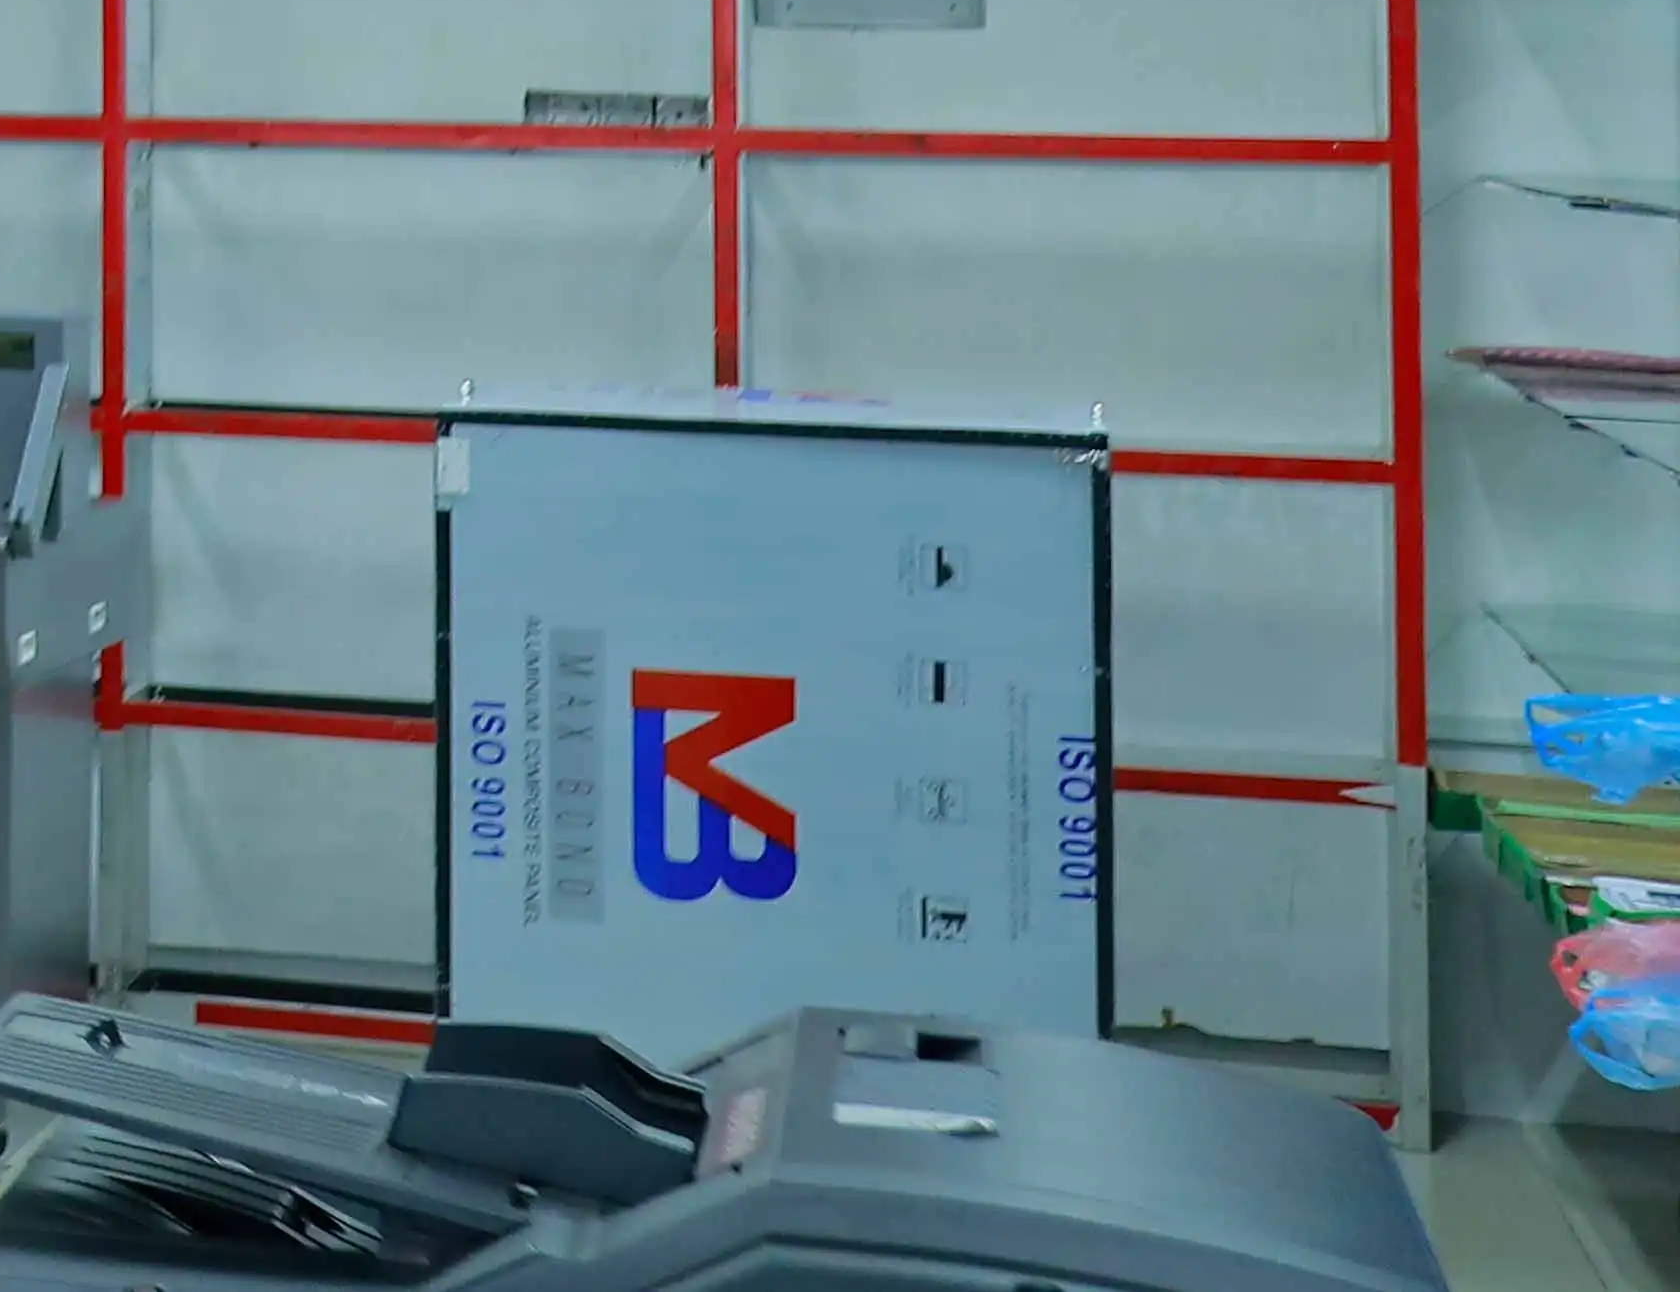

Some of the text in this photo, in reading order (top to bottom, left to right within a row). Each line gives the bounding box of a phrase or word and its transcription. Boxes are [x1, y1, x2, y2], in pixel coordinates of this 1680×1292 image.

[470, 700, 508, 861] ISO 9001
[555, 652, 597, 899] MAX BOND
[1057, 734, 1098, 902] ISO 9001
